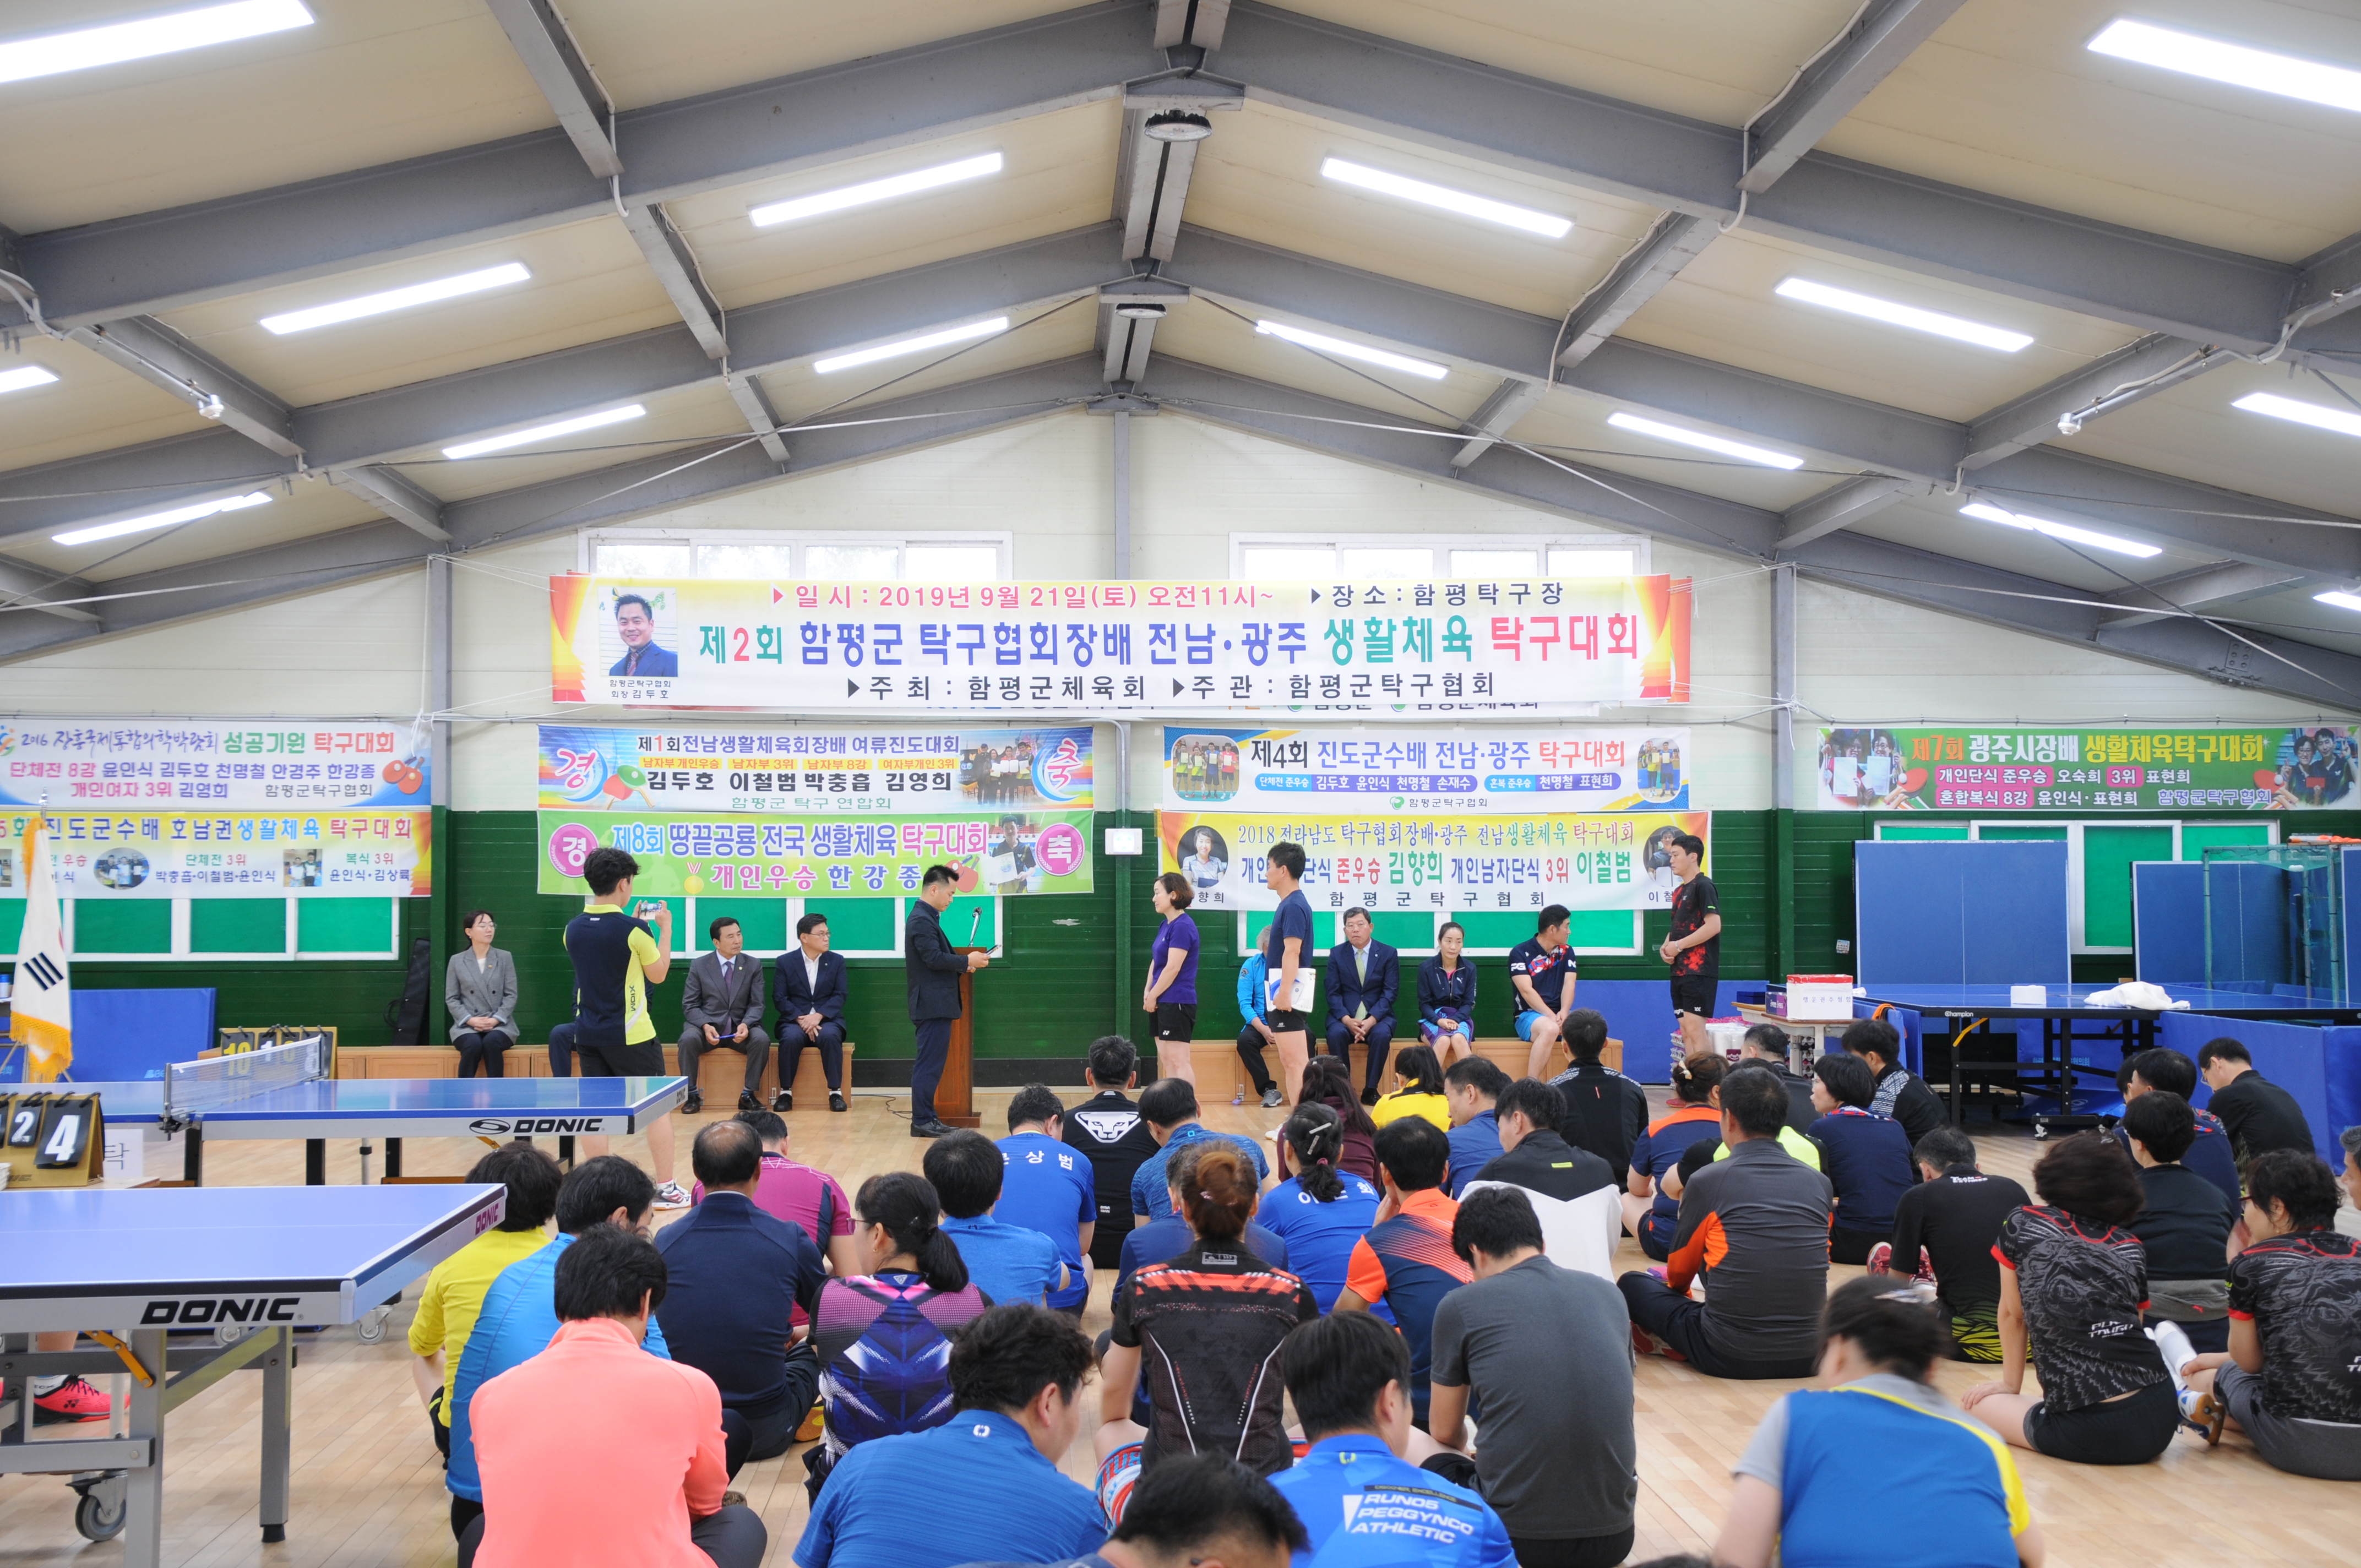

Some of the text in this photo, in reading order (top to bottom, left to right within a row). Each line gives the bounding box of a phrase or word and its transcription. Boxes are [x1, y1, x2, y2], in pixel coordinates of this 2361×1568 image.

[879, 586, 969, 608] 2019년
[980, 586, 1019, 608] 9월
[1030, 585, 1136, 608] 21일(토)
[1413, 582, 1563, 606] 함평탁구장
[699, 613, 1637, 667] 제2회 함평군 탁구협회장배 전남·광주 생활체육 탁구대회
[610, 679, 671, 688] 함평군탁구협회
[969, 676, 1144, 700] 함평군체육회
[1289, 672, 1493, 699] 함평군탁구협회
[611, 690, 628, 699] 회장
[21, 734, 48, 747] 2016
[224, 732, 305, 754] 성공기원
[314, 732, 394, 754] 탁구대회
[852, 736, 959, 754] 여류진도대회
[1912, 735, 1963, 761] 제7회
[1968, 734, 2079, 763] 광주시장배
[643, 758, 719, 770] 남자부 개인우승
[732, 759, 794, 770] 남자부 3위
[808, 759, 867, 770] 남자부 8강
[883, 759, 955, 770] 여자부개인 3위
[1047, 739, 1081, 790] 축
[1251, 741, 1625, 770] 제4회 진도군수배 전남·광주 탁구대회
[10, 762, 375, 780] 단체전 8강 윤인식 김두호 천명철 안경주 한강종
[557, 750, 596, 788] 경
[1939, 769, 2190, 784] 개인단식 준우승 오숙희 3위 표현희
[71, 782, 372, 798] 개인여자 3위 김영희 함평군탁구협회
[648, 771, 714, 791] 김두호
[730, 772, 796, 792] 이철범
[804, 772, 871, 792] 박충흡
[886, 772, 951, 792] 김영희
[1260, 776, 1471, 791] 단체전 준우승 김두호 윤인식 천명철 손재수
[1490, 774, 1612, 790] 혼복 준우승 천명철 표현희
[837, 797, 891, 809] 연합회
[1409, 798, 1487, 808] 함평군탁구협회
[1939, 790, 1998, 805] 혼합복식
[2003, 791, 2027, 805] 8강
[2158, 789, 2271, 805] 함평군탁구협회
[330, 818, 411, 839] 탁구대회
[1238, 825, 1275, 844] 2018
[1279, 824, 1336, 846] 전라남도
[1574, 820, 1634, 846] 탁구대회
[613, 824, 987, 857] 제8회 땅끝공룡 전국 생활체육 탁구대회
[1047, 835, 1073, 864] 축
[62, 854, 88, 867] 우승
[186, 854, 247, 866] 단체전 3위
[346, 853, 394, 864] 복식 3위
[563, 837, 586, 867] 경
[712, 865, 817, 889] 개인우승
[1337, 857, 1380, 885] 준우승
[1389, 851, 1443, 886] 김향희
[1451, 858, 1539, 884] 개인남자단식
[1546, 858, 1569, 884] 3위
[1576, 850, 1631, 884] 이철범
[12, 1111, 35, 1142] 2
[513, 1118, 603, 1133] DONIC
[476, 1203, 499, 1235] DONIC
[140, 1298, 301, 1324] DONIC
[1350, 1522, 1456, 1544] ATHLETIC
